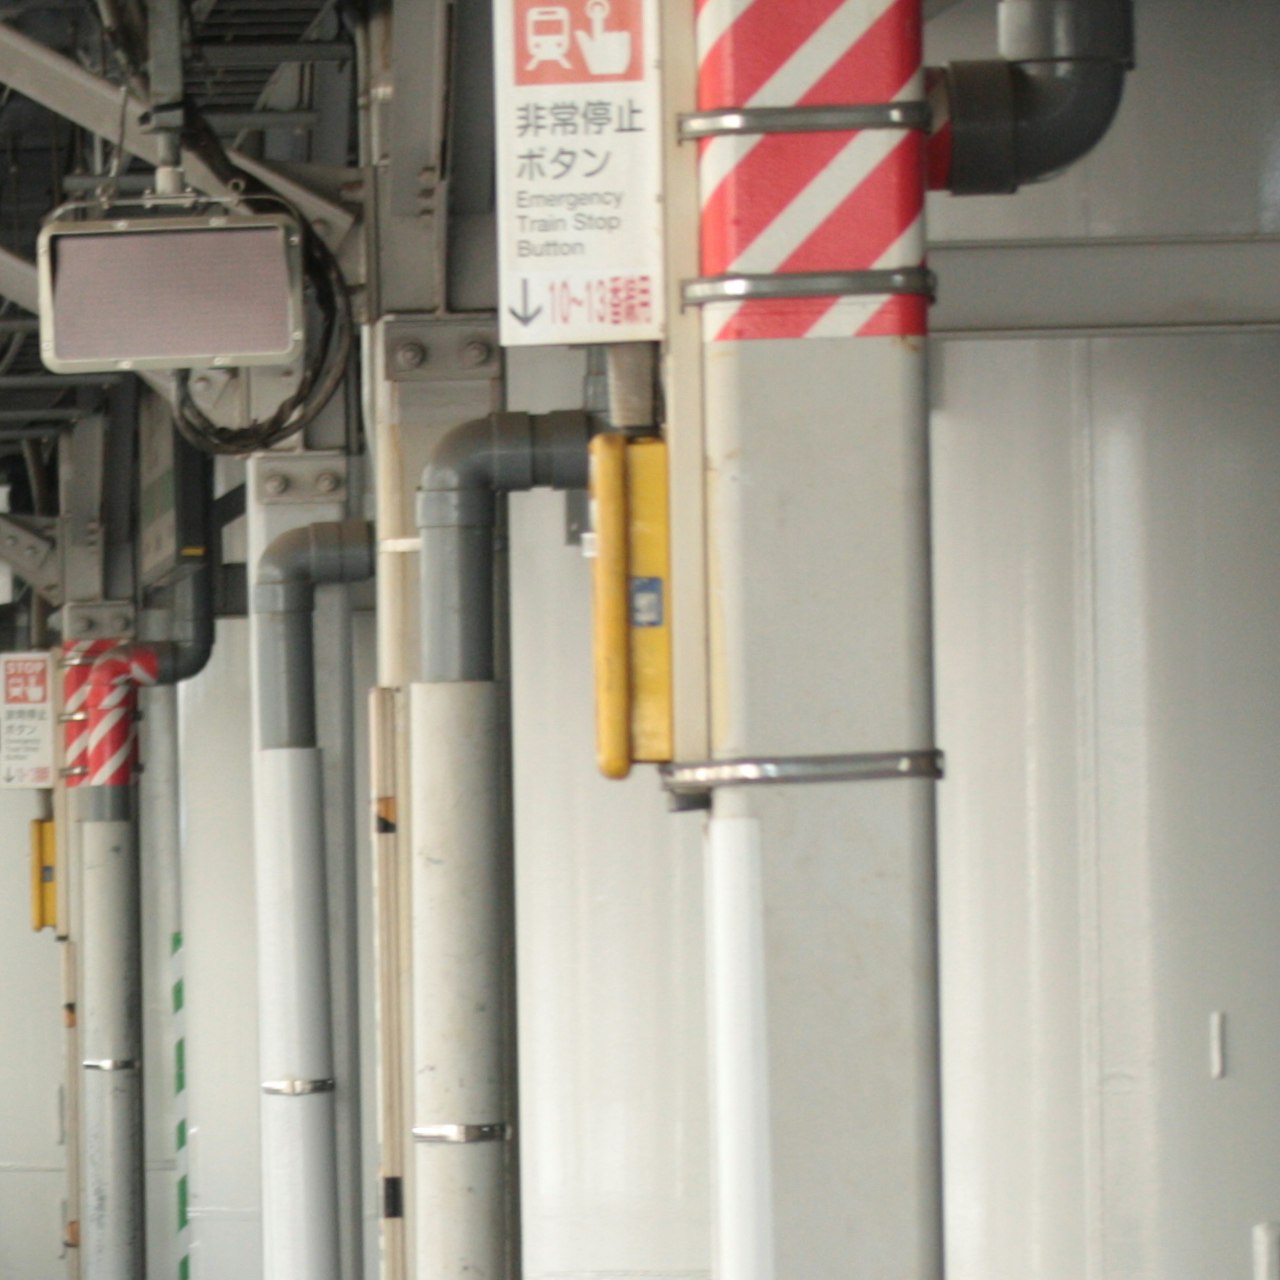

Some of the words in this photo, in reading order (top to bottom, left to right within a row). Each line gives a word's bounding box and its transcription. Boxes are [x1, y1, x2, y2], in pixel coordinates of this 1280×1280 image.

[515, 99, 645, 138] 非常停止
[516, 147, 613, 182] ボタン
[516, 190, 624, 211] Emergency
[517, 215, 567, 233] Train
[573, 213, 622, 234] Stop
[517, 239, 586, 258] Button
